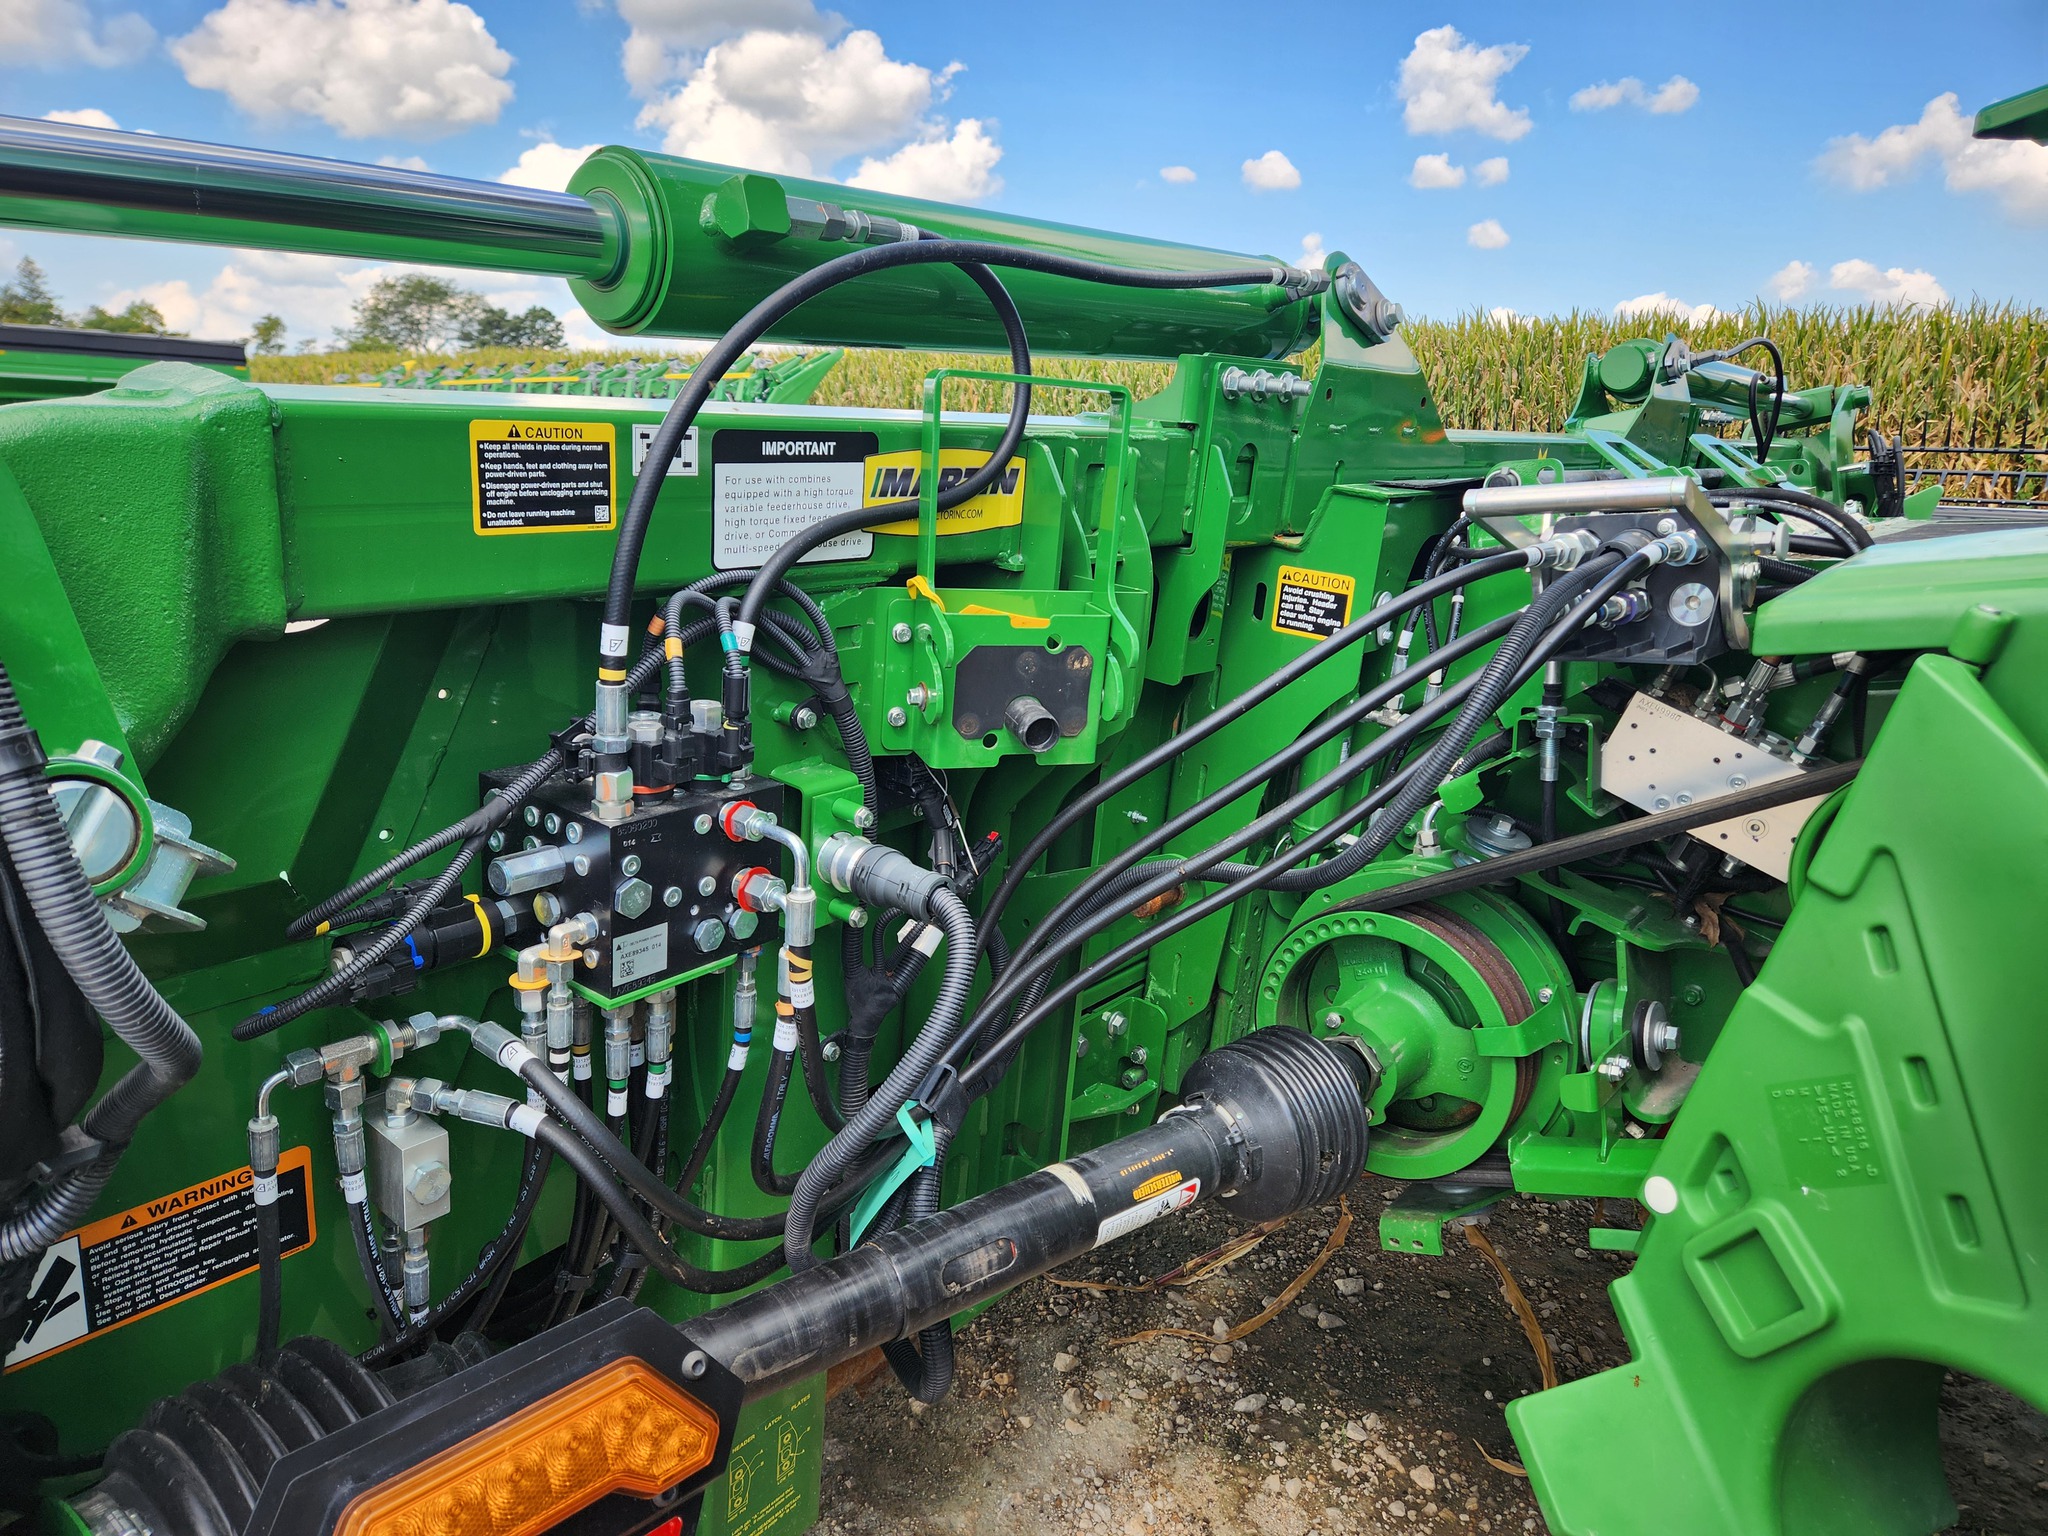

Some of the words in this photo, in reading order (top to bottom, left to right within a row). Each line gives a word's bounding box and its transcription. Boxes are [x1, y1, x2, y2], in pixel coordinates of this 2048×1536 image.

[525, 427, 583, 439] CAUTION
[484, 443, 501, 451] Keep
[543, 443, 560, 452] place
[561, 443, 581, 452] during
[484, 451, 521, 460] operations.
[761, 441, 836, 456] IMPORTANT
[485, 462, 502, 471] Keep
[503, 462, 525, 470] hands,
[526, 462, 538, 470] feet
[539, 462, 551, 470] and
[552, 462, 577, 471] clothing
[578, 463, 593, 471] away
[485, 470, 527, 479] power-driven
[529, 470, 547, 478] parts.
[486, 482, 519, 490] Disengage
[521, 481, 560, 490] power-driven
[561, 481, 577, 489] parts
[725, 475, 741, 485] For
[745, 477, 762, 485] use
[765, 475, 785, 484] with
[788, 474, 831, 484] combines
[486, 490, 495, 498] off
[496, 490, 518, 499] engine
[519, 489, 539, 497] before
[540, 489, 573, 498] unclogging
[582, 488, 608, 497] servicing
[725, 489, 769, 501] equipped
[773, 489, 792, 498] with
[804, 488, 823, 499] high
[826, 487, 854, 497] torque
[486, 498, 516, 506] machine.
[725, 502, 763, 513] variable
[767, 501, 823, 511] feederhouse
[826, 499, 850, 510] drive,
[486, 511, 496, 519] Do
[526, 509, 550, 518] running
[551, 508, 576, 516] machine
[487, 518, 524, 527] unattended.
[724, 518, 746, 529] high
[750, 518, 780, 528] torque
[783, 515, 806, 524] fixed
[724, 531, 752, 541] drive,
[755, 531, 765, 539] or
[841, 537, 864, 546] drive.
[1293, 572, 1350, 591] CAUTION
[1283, 585, 1303, 595] Avoid
[1304, 588, 1335, 602] crushing
[1280, 610, 1297, 618] clear
[1298, 612, 1316, 622] when
[1317, 618, 1341, 627] engine
[1295, 604, 1306, 612] tilt.
[1309, 606, 1325, 617] Stay
[1827, 1083, 1845, 1117] MADE
[1838, 1125, 1851, 1139] IN
[1845, 1146, 1861, 1171] USA
[1133, 1171, 1183, 1200] WALTERSCHEID
[147, 1170, 253, 1218] WARNING
[88, 1241, 111, 1255] Avoid
[114, 1229, 143, 1245] serious
[146, 1220, 168, 1233] injury
[172, 1212, 189, 1223] from
[192, 1200, 219, 1215] contact
[222, 1193, 237, 1203] with
[366, 1224, 373, 1233] IN
[89, 1254, 99, 1263] oil
[103, 1247, 118, 1258] and
[121, 1241, 136, 1252] gas
[139, 1231, 162, 1244] under
[165, 1216, 199, 1235] pressure.
[368, 1233, 380, 1259] MADE
[90, 1256, 116, 1271] Before
[120, 1241, 156, 1260] removing
[159, 1226, 193, 1245] hydraulic
[101, 1268, 129, 1283] Relieve
[133, 1255, 160, 1271] system
[163, 1240, 197, 1259] hydraulic
[200, 1224, 238, 1244] pressures.
[103, 1256, 140, 1275] changing
[142, 1234, 194, 1259] accumulators:
[102, 1283, 110, 1291] to
[114, 1268, 148, 1287] Operator
[151, 1256, 178, 1271] Manual
[181, 1249, 195, 1259] and
[198, 1238, 222, 1253] Repair
[224, 1226, 250, 1241] Manual
[479, 1247, 495, 1270] MSHA
[95, 1307, 111, 1318] Use
[114, 1299, 132, 1311] only
[135, 1290, 152, 1302] DRY
[155, 1272, 195, 1293] NITROGEN
[198, 1267, 208, 1276] for
[211, 1250, 249, 1270] recharging
[103, 1283, 131, 1299] system
[134, 1264, 179, 1286] information.
[103, 1294, 122, 1307] Stop
[125, 1282, 152, 1299] engine
[155, 1275, 169, 1285] and
[172, 1263, 199, 1278] remove
[202, 1256, 216, 1267] key.
[96, 1315, 111, 1326] See
[114, 1306, 133, 1319] your
[136, 1297, 155, 1309] John
[159, 1287, 180, 1300] Deere
[183, 1276, 207, 1289] dealer.
[732, 1434, 755, 1454] HEADER
[764, 1414, 782, 1431] LATCH
